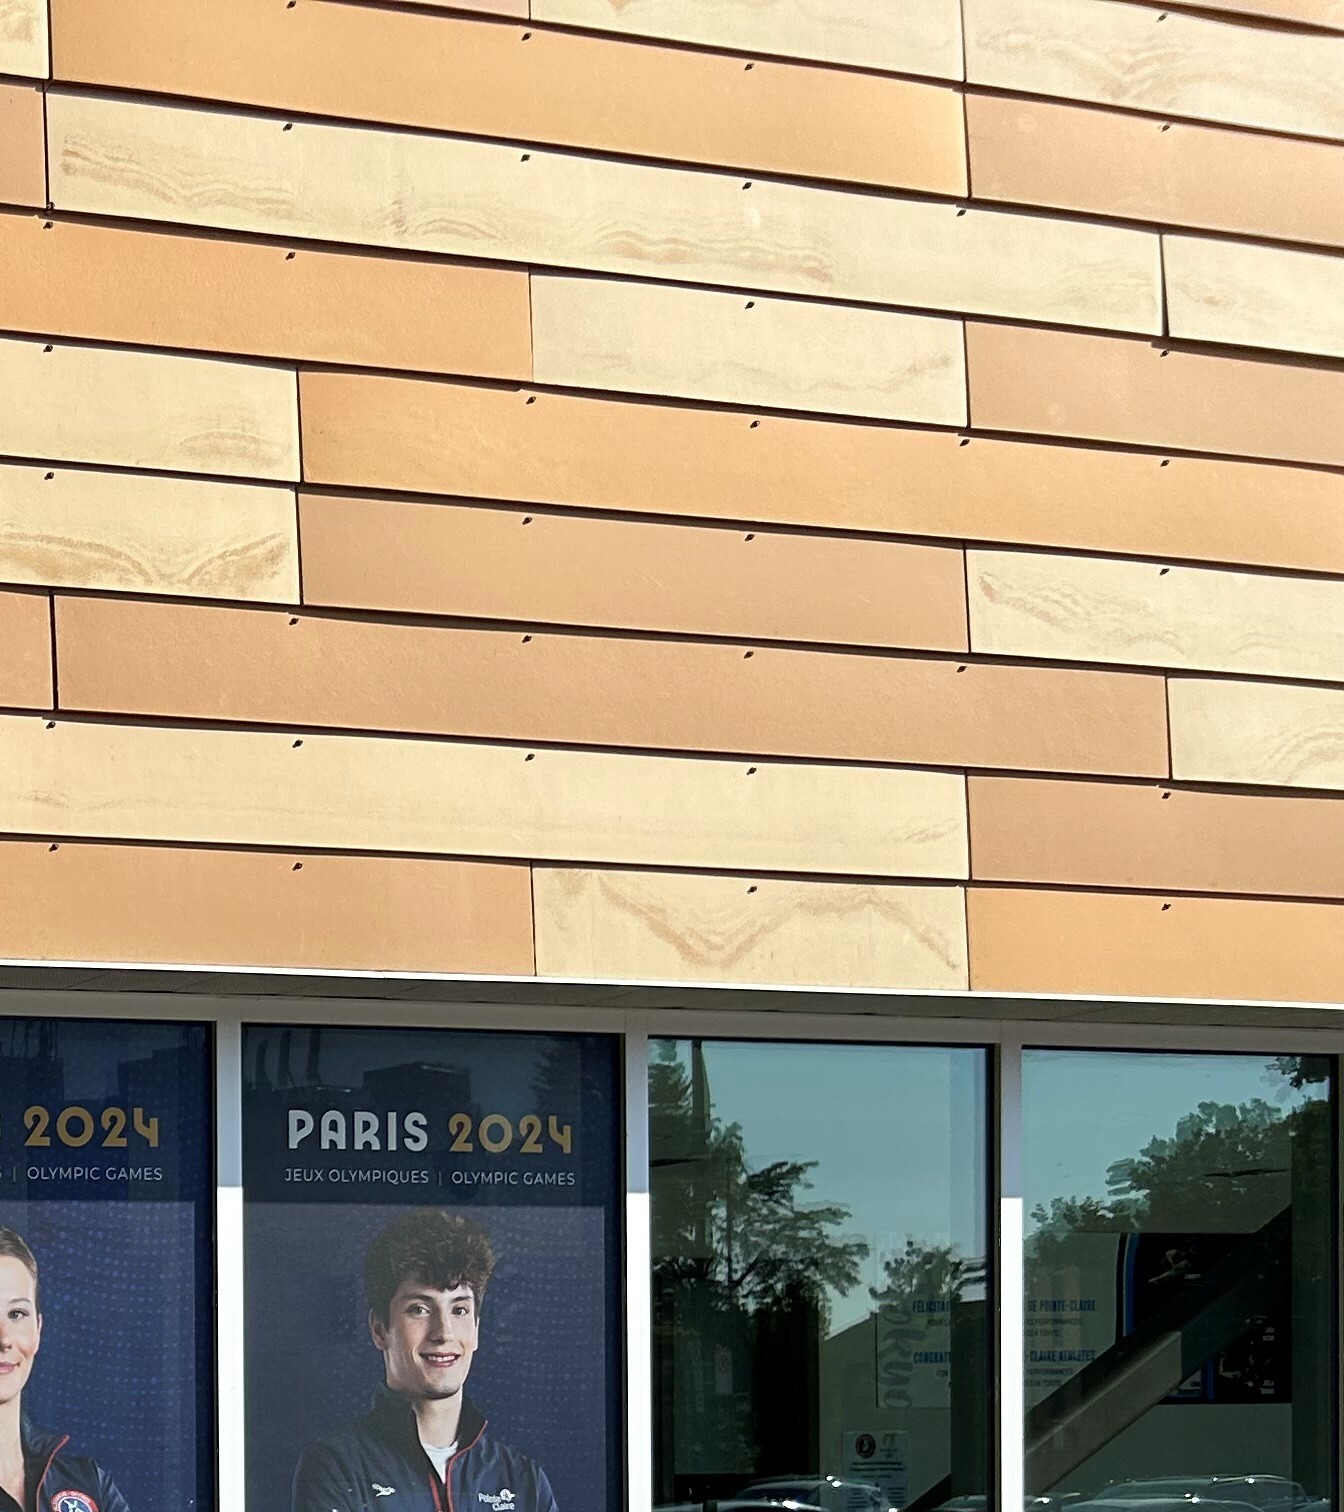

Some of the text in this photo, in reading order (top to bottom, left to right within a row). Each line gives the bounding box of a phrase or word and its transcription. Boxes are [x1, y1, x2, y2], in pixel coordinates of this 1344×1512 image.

[23, 1105, 159, 1148] 2024
[288, 1109, 574, 1155] PARIS 2024
[26, 1166, 162, 1181] OLYMPIC GAMES
[284, 1168, 429, 1186] JEUX OLYMPIQUES
[451, 1170, 575, 1186] OLYMPIC GAMES
